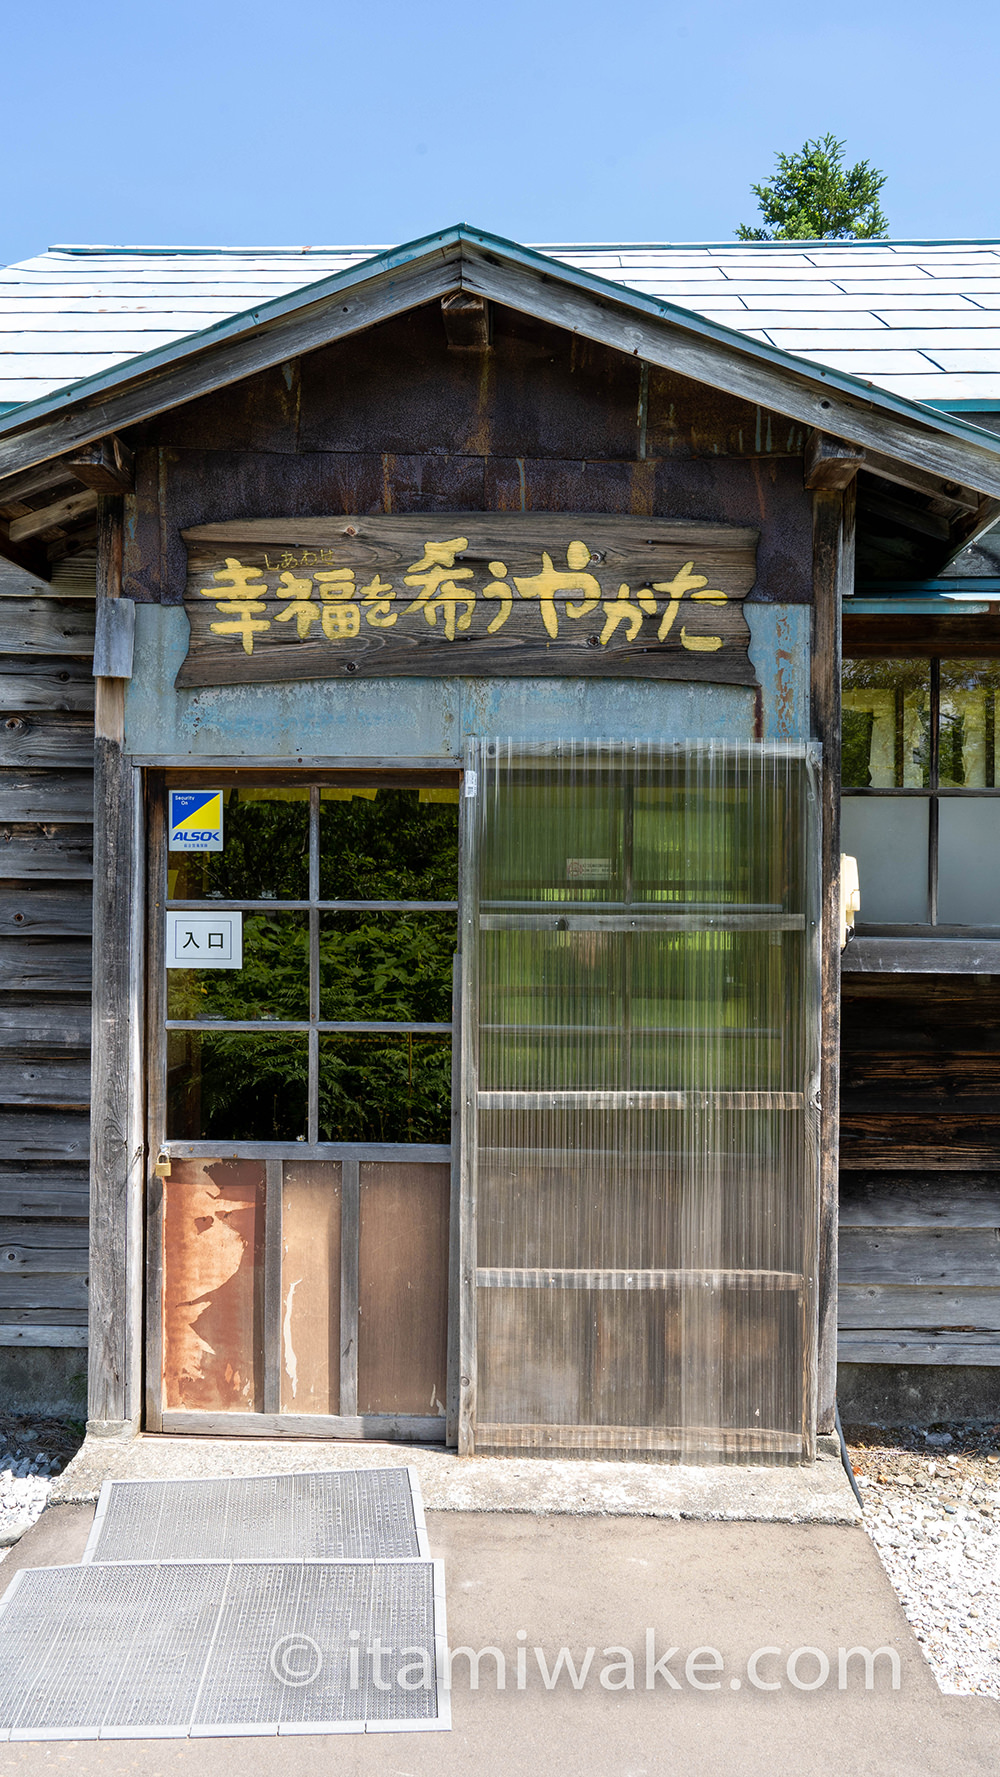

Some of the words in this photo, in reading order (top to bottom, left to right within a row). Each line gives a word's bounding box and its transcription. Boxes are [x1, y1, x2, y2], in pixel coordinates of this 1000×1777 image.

[264, 549, 335, 571] しあわせ
[200, 537, 728, 655] 幸福を希うやかた
[172, 831, 220, 842] ALSOK
[183, 931, 224, 949] 入口
